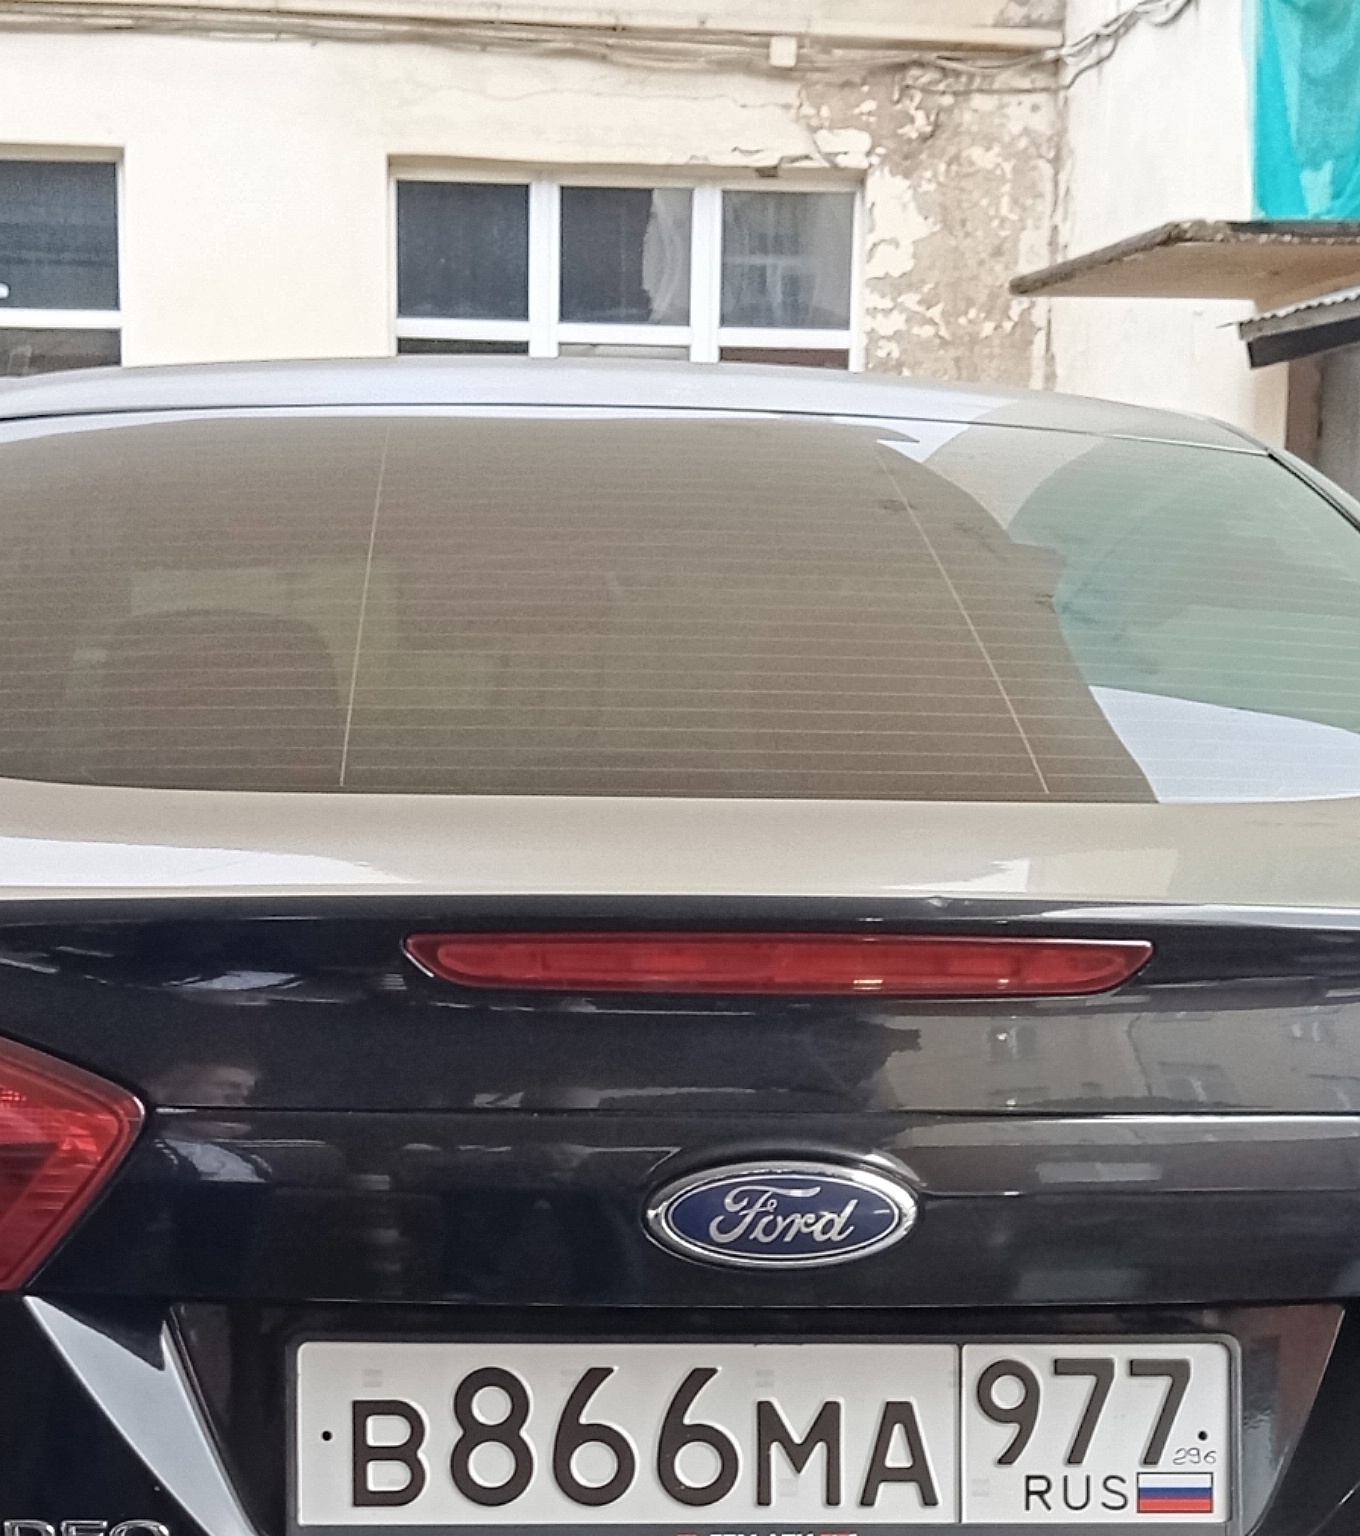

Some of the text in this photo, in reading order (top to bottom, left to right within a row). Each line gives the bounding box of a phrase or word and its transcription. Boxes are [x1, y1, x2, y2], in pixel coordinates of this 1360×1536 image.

[709, 1185, 858, 1243] Ford
[977, 1358, 1190, 1466] 977
[1172, 1447, 1217, 1466] 296
[1025, 1474, 1128, 1511] RUS
